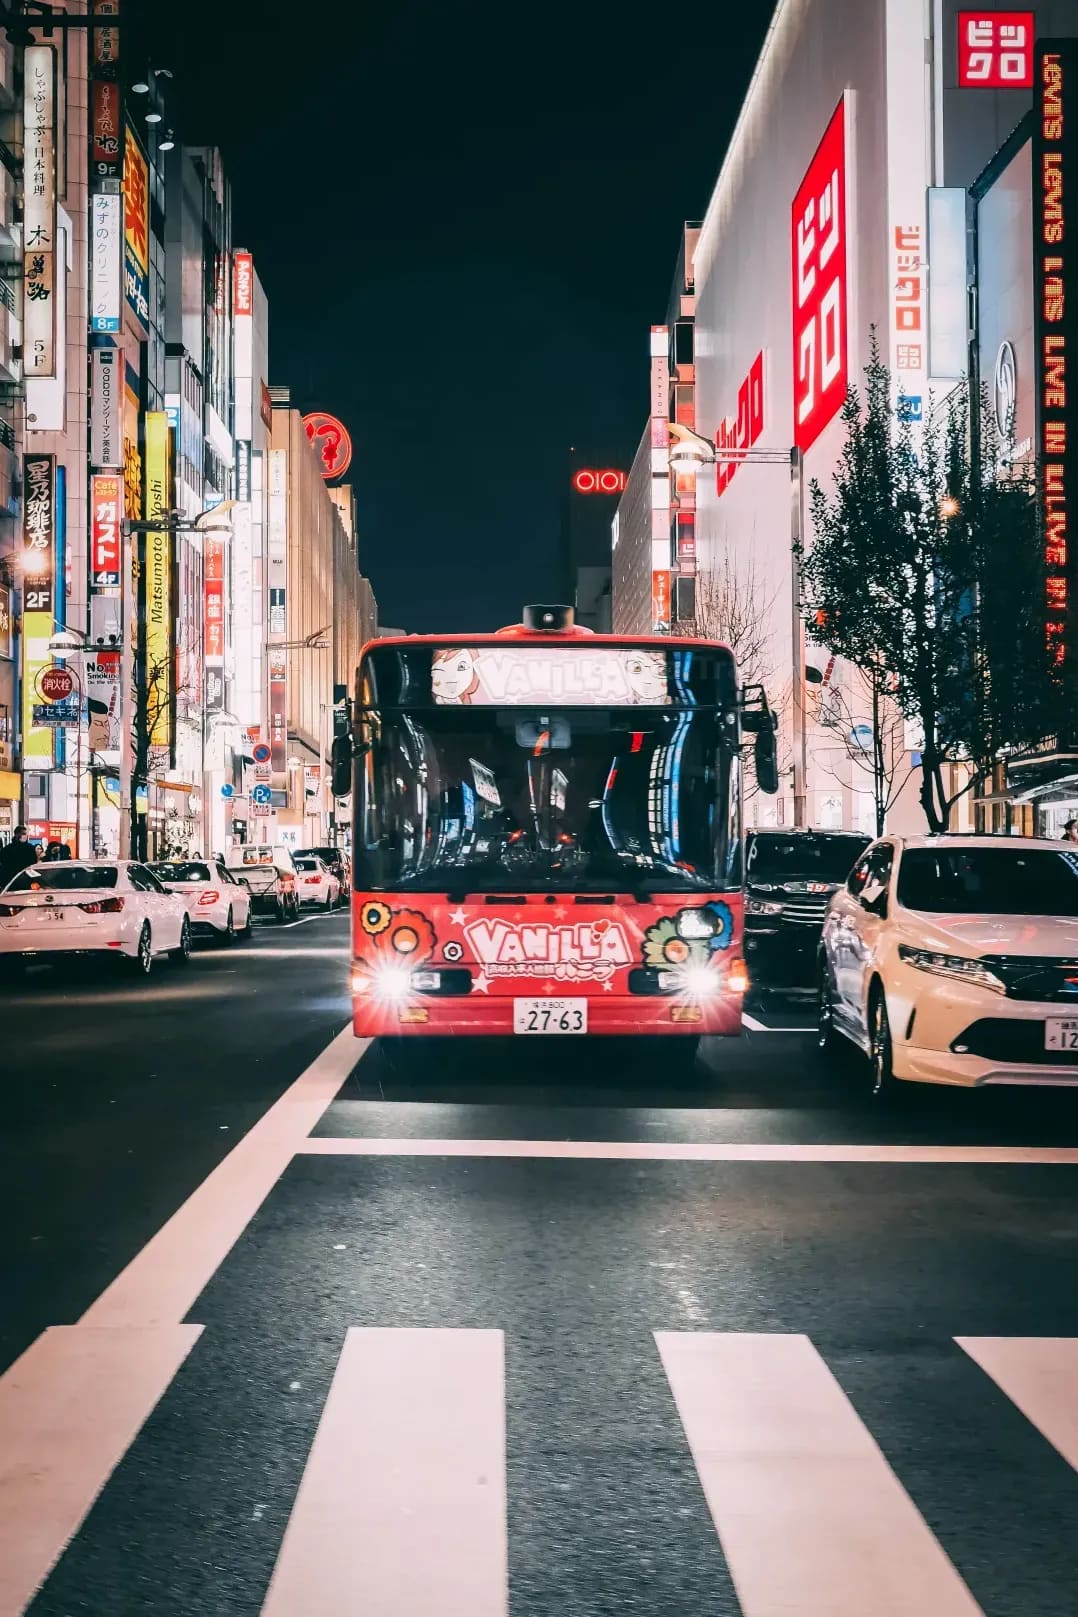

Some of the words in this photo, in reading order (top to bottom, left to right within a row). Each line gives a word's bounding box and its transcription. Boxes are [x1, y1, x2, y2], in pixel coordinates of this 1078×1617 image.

[966, 20, 1026, 80] ビックロ
[33, 67, 46, 196] しゃぶしゃぶ・日本料理
[97, 163, 117, 175] 9F
[797, 167, 843, 426] ビックロ
[895, 226, 921, 331] ビックロ
[97, 319, 114, 330] 8F
[34, 340, 46, 367] 5F
[1044, 336, 1065, 408] LIVE
[1045, 422, 1066, 453] IN
[26, 461, 50, 550] 星乃珈琲店
[97, 502, 116, 565] ガスト
[96, 572, 116, 584] 4F
[150, 537, 163, 624] Matsumoto
[26, 592, 50, 608] 2F
[44, 678, 71, 691] 消火栓
[87, 662, 104, 673] No
[475, 655, 628, 699] VANILLA
[469, 923, 631, 966] VANILLA
[527, 1010, 583, 1031] 27-63
